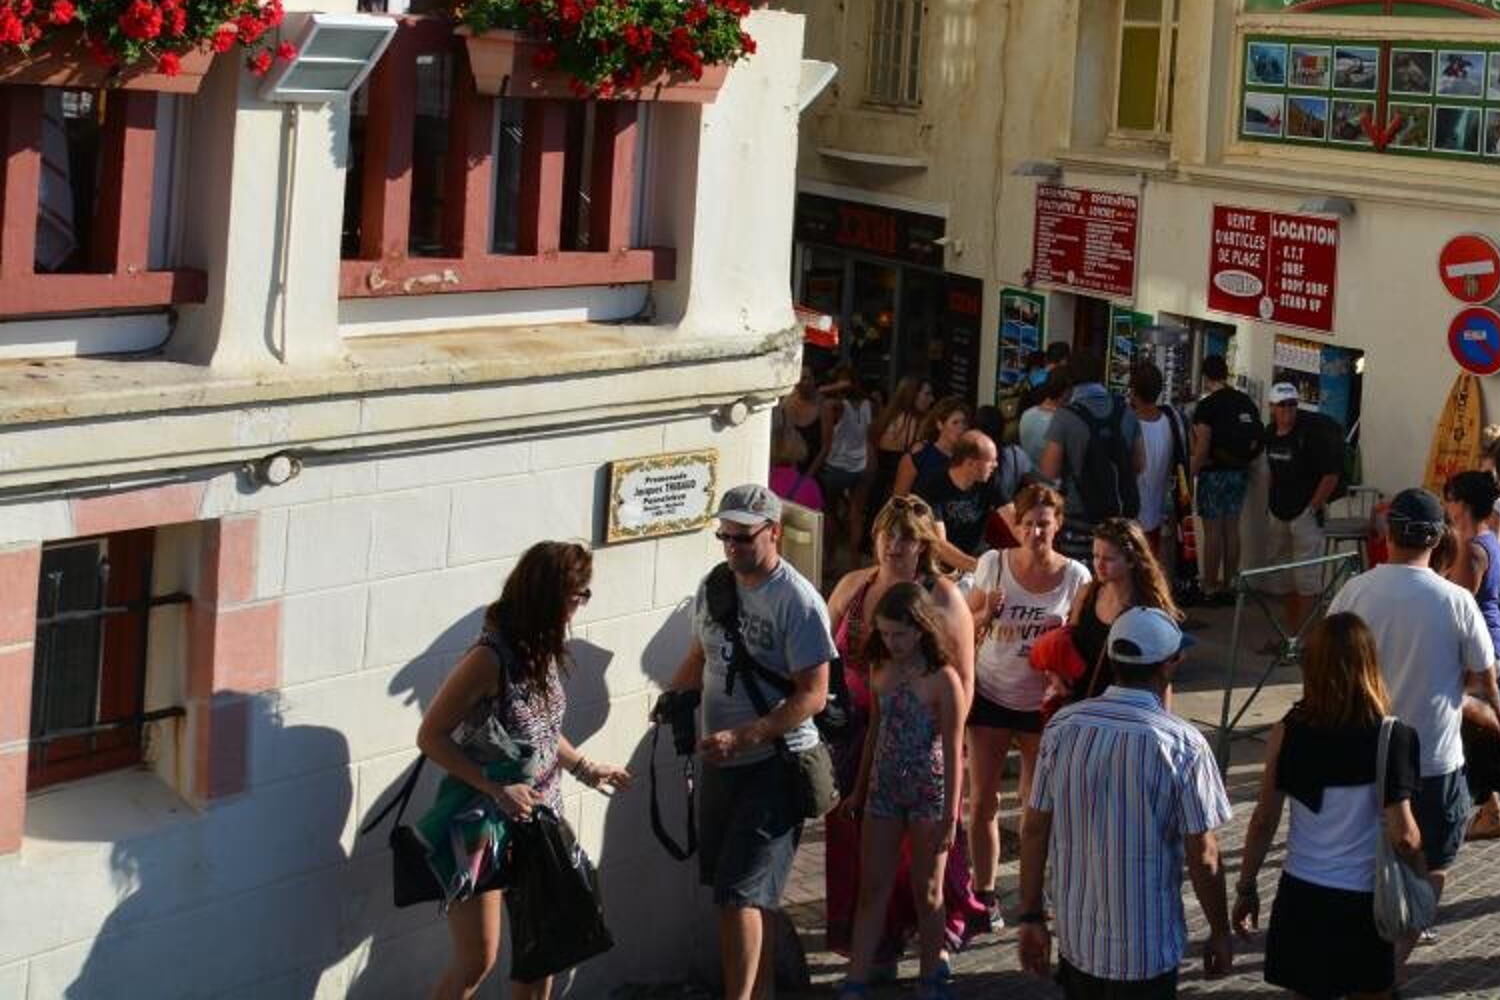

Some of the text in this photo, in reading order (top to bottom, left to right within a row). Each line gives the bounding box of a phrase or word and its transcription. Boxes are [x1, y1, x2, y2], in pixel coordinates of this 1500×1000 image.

[1227, 213, 1256, 230] VENTE
[1215, 229, 1266, 251] D'ARTICLES
[1273, 219, 1336, 245] LOCATION
[1218, 248, 1260, 268] DE PLAGE
[1282, 262, 1304, 276] SURF
[1281, 278, 1328, 296] BODY SURF
[1280, 293, 1307, 310] STAND
[646, 473, 687, 484] Promenade
[1010, 606, 1046, 620] THE
